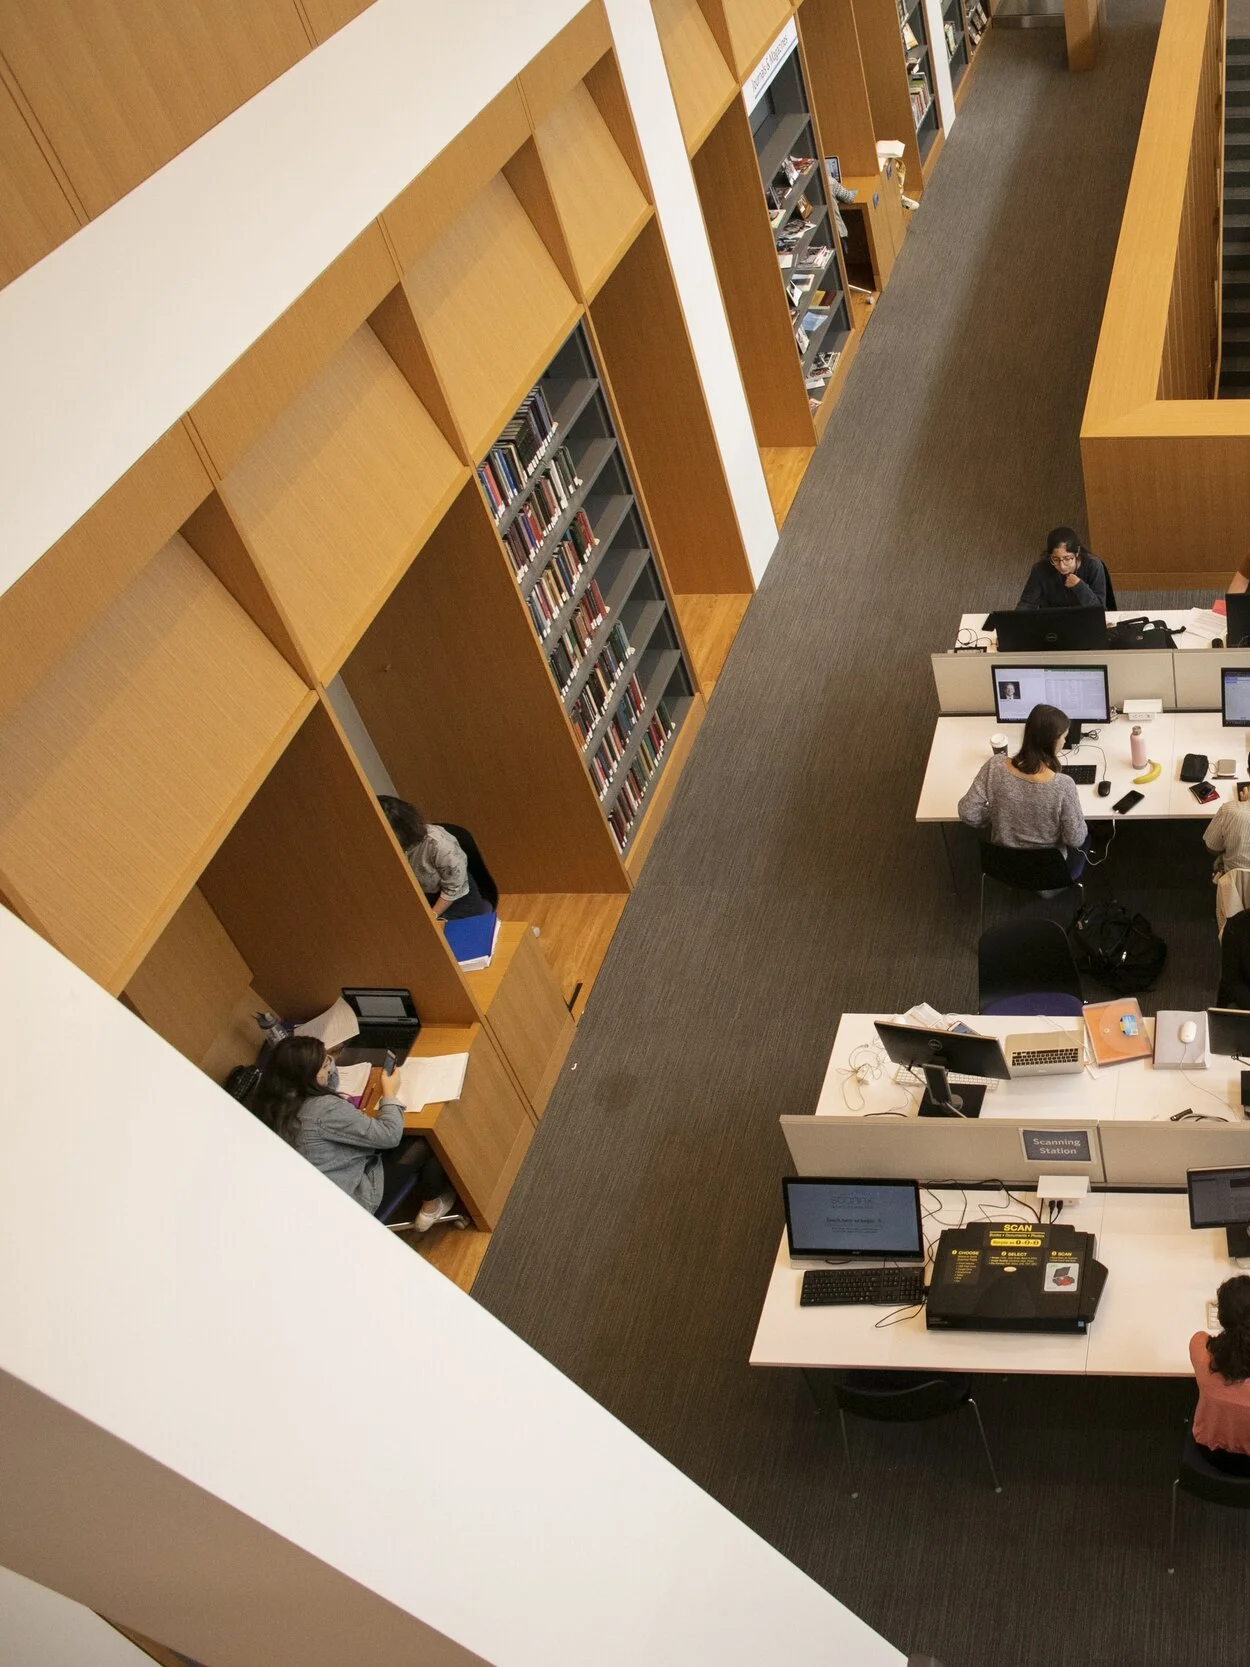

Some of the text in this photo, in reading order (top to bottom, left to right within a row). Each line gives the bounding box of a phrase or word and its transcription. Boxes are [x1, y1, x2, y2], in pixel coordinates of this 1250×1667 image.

[1033, 1138, 1081, 1146] Scanning
[1039, 1147, 1077, 1155] Station
[1003, 1224, 1033, 1232] SCAN
